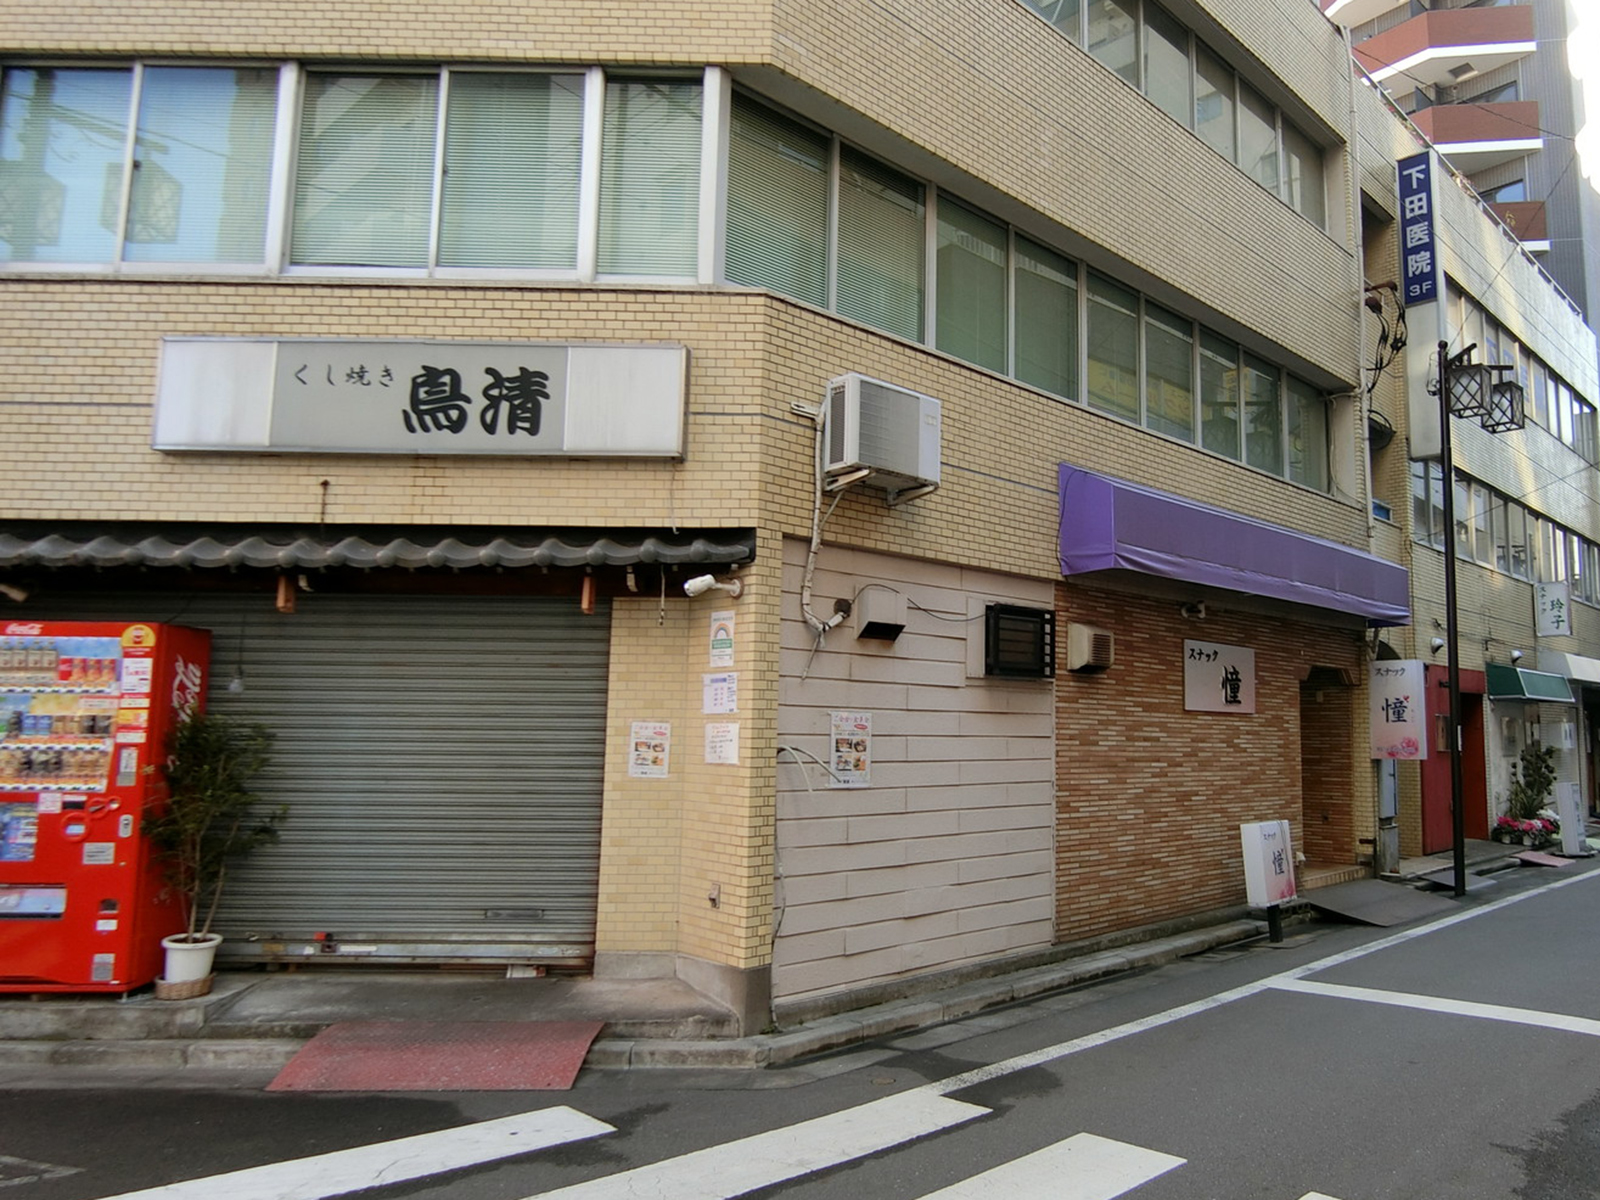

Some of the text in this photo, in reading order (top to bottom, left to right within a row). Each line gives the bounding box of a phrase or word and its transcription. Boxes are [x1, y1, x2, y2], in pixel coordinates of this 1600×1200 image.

[1402, 164, 1431, 278] 下田医院
[1409, 281, 1433, 297] 3F
[295, 364, 551, 437] くし焼き 鳥清
[1550, 598, 1565, 629] 玲子
[1188, 648, 1219, 662] スナック
[1221, 665, 1242, 704] 憧
[1375, 667, 1406, 677] スナック
[1382, 698, 1408, 723] 憧
